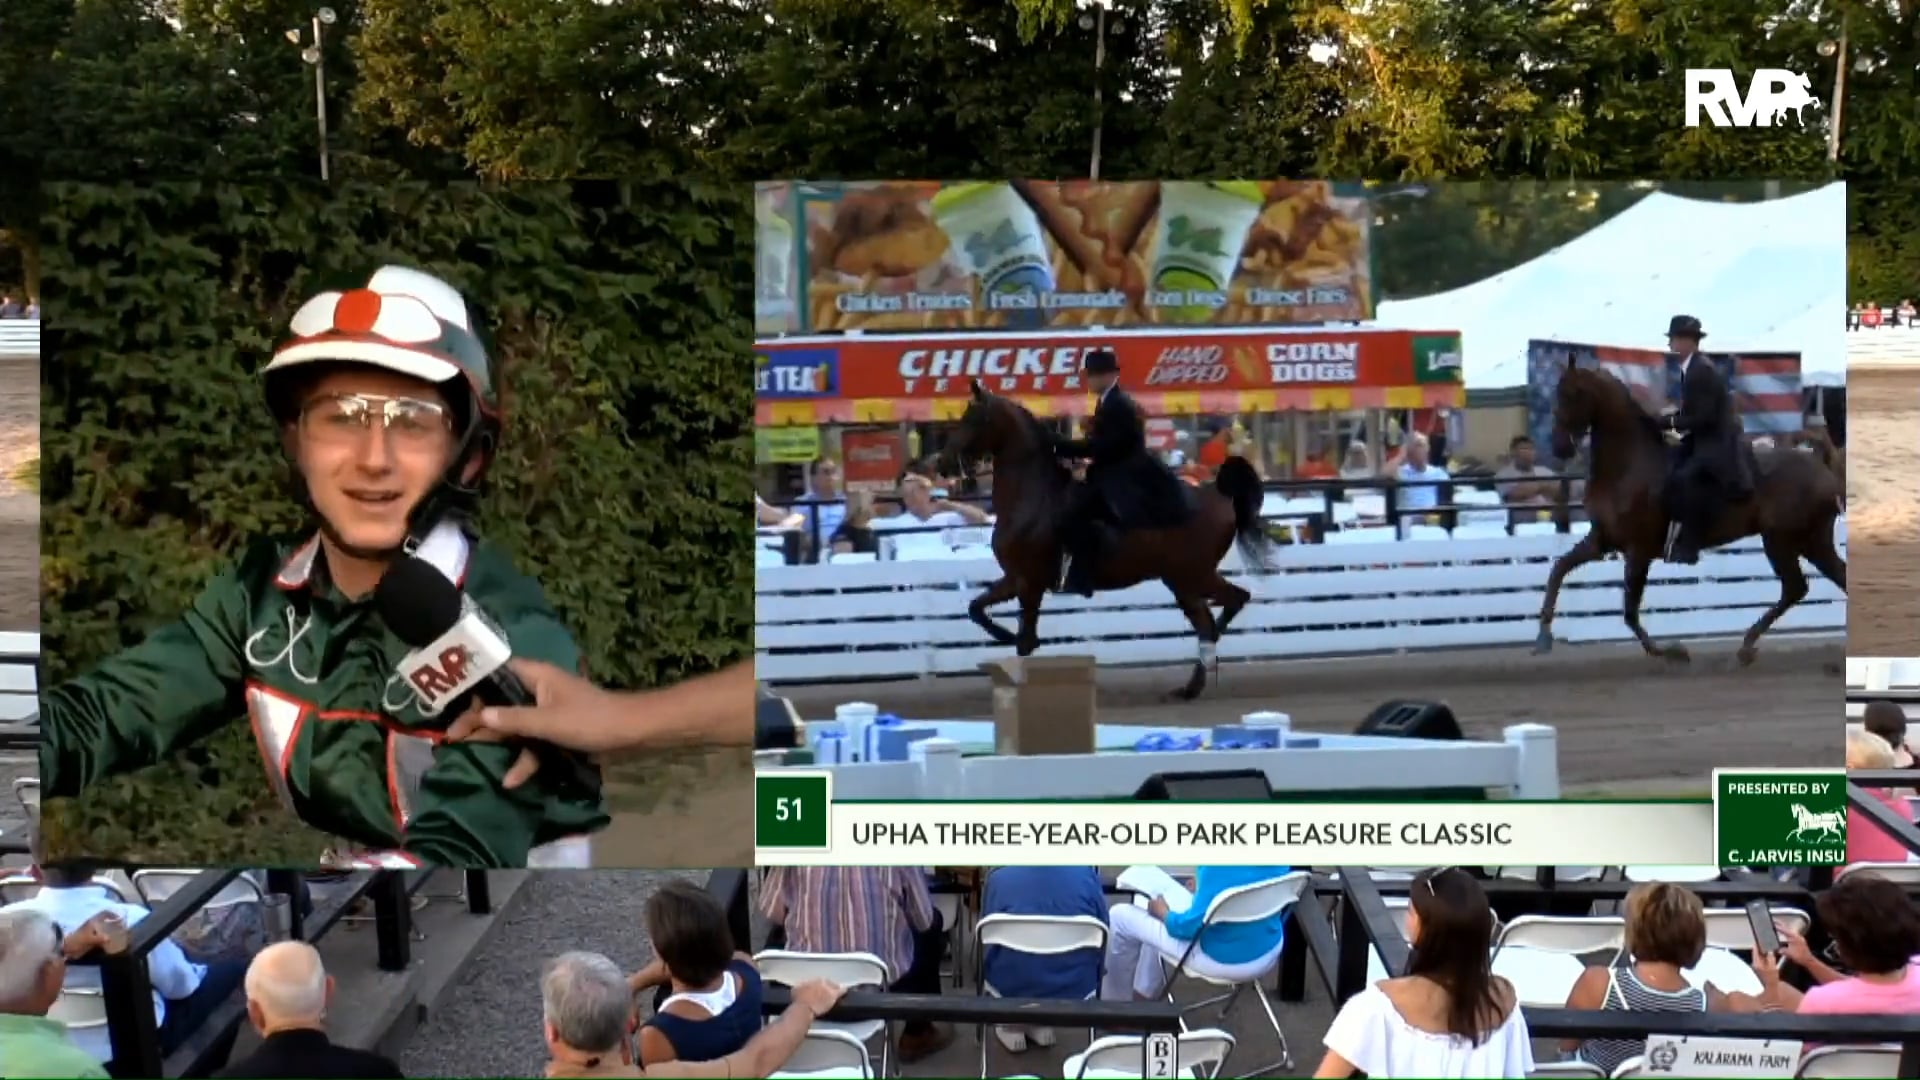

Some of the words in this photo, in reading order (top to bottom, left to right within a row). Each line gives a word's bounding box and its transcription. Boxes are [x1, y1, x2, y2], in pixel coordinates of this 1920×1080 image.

[1157, 345, 1223, 364] HAND
[1266, 342, 1358, 363] CORN
[1145, 363, 1228, 384] DIPPED
[1271, 362, 1357, 383] DOGS
[1154, 1040, 1169, 1058] B
[1155, 1060, 1167, 1077] 2
[1693, 1050, 1753, 1067] KALARAMA
[1759, 1054, 1790, 1069] FARM
